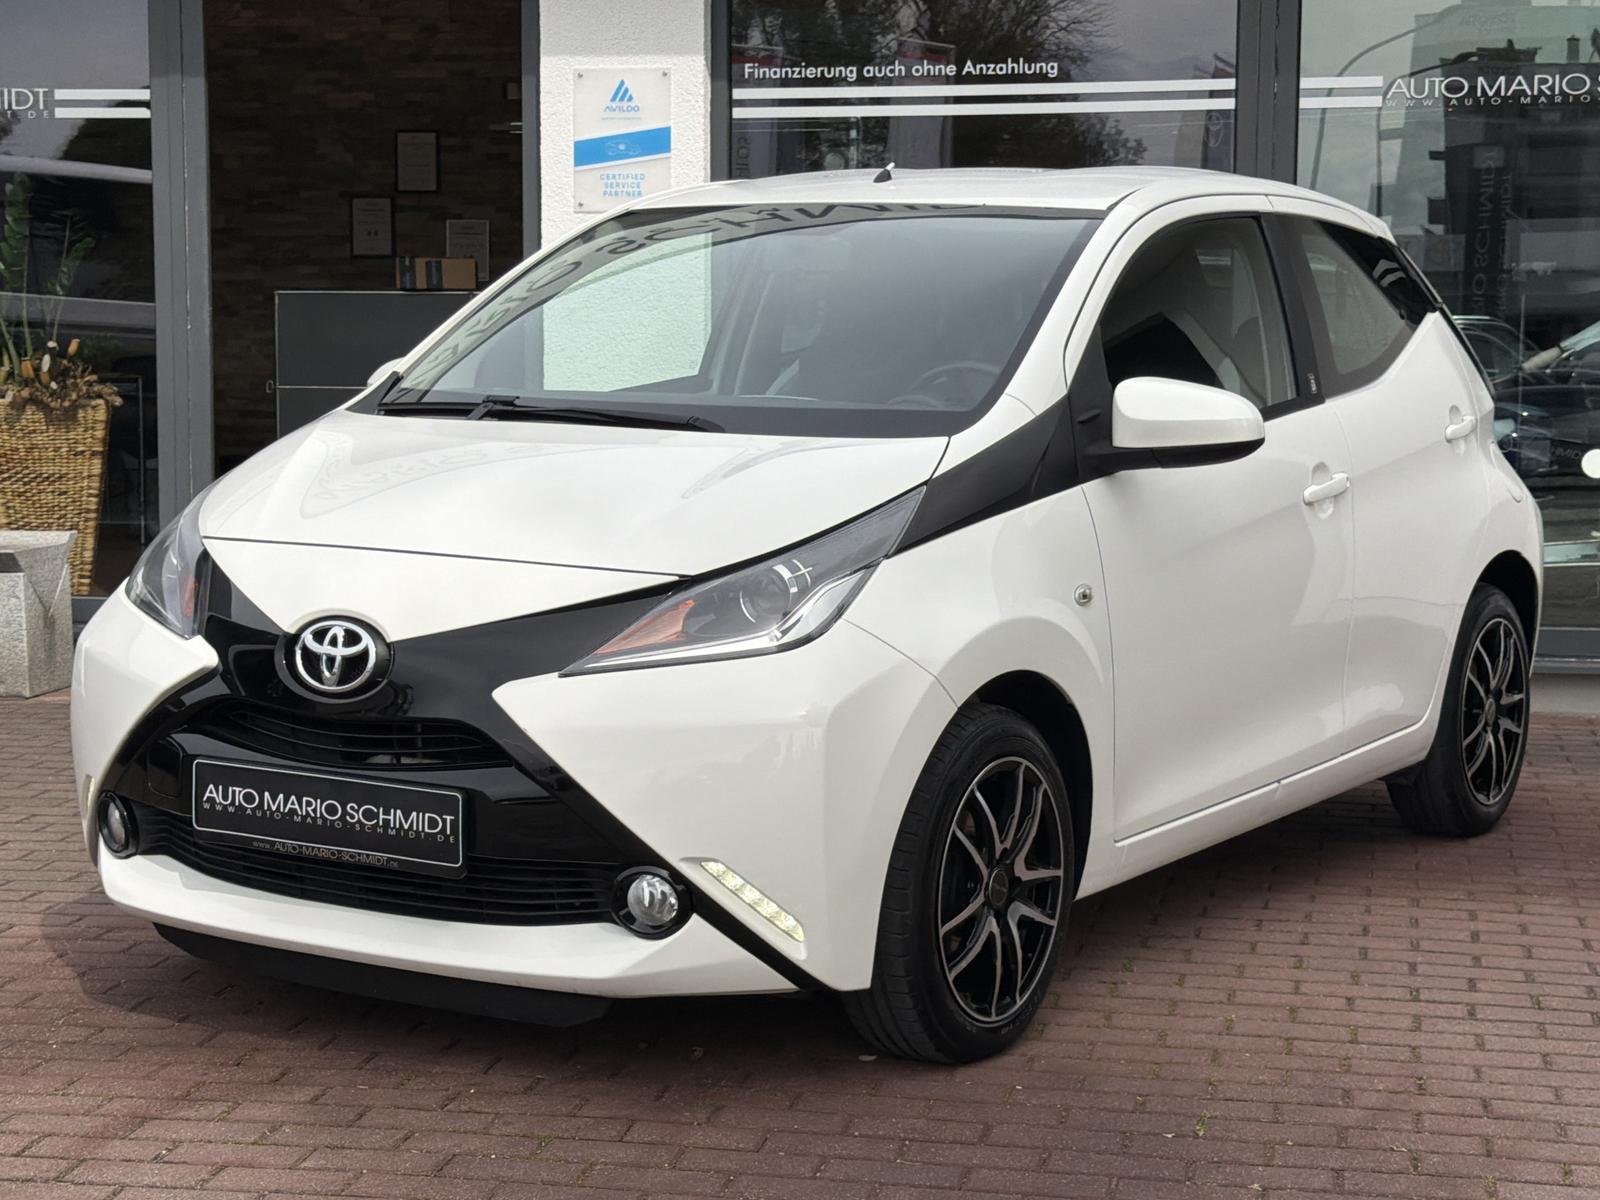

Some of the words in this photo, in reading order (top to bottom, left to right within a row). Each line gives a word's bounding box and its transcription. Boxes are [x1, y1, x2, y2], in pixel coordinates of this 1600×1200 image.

[744, 62, 858, 82] Finanzierung
[863, 60, 906, 77] auch
[911, 60, 957, 77] ohne
[962, 57, 1058, 78] Anzahlung
[0, 87, 49, 110] IDT
[1386, 76, 1469, 99] AUTO
[1476, 73, 1591, 97] MARIO
[600, 173, 646, 181] CERTIFIED
[602, 190, 643, 198] PARTNER
[203, 784, 259, 808] AUTO
[264, 791, 342, 820] MARIO
[346, 803, 455, 835] SCHMIDT
[203, 802, 456, 843] WWW.AUTO-MARIO-SCHMIDT.DE
